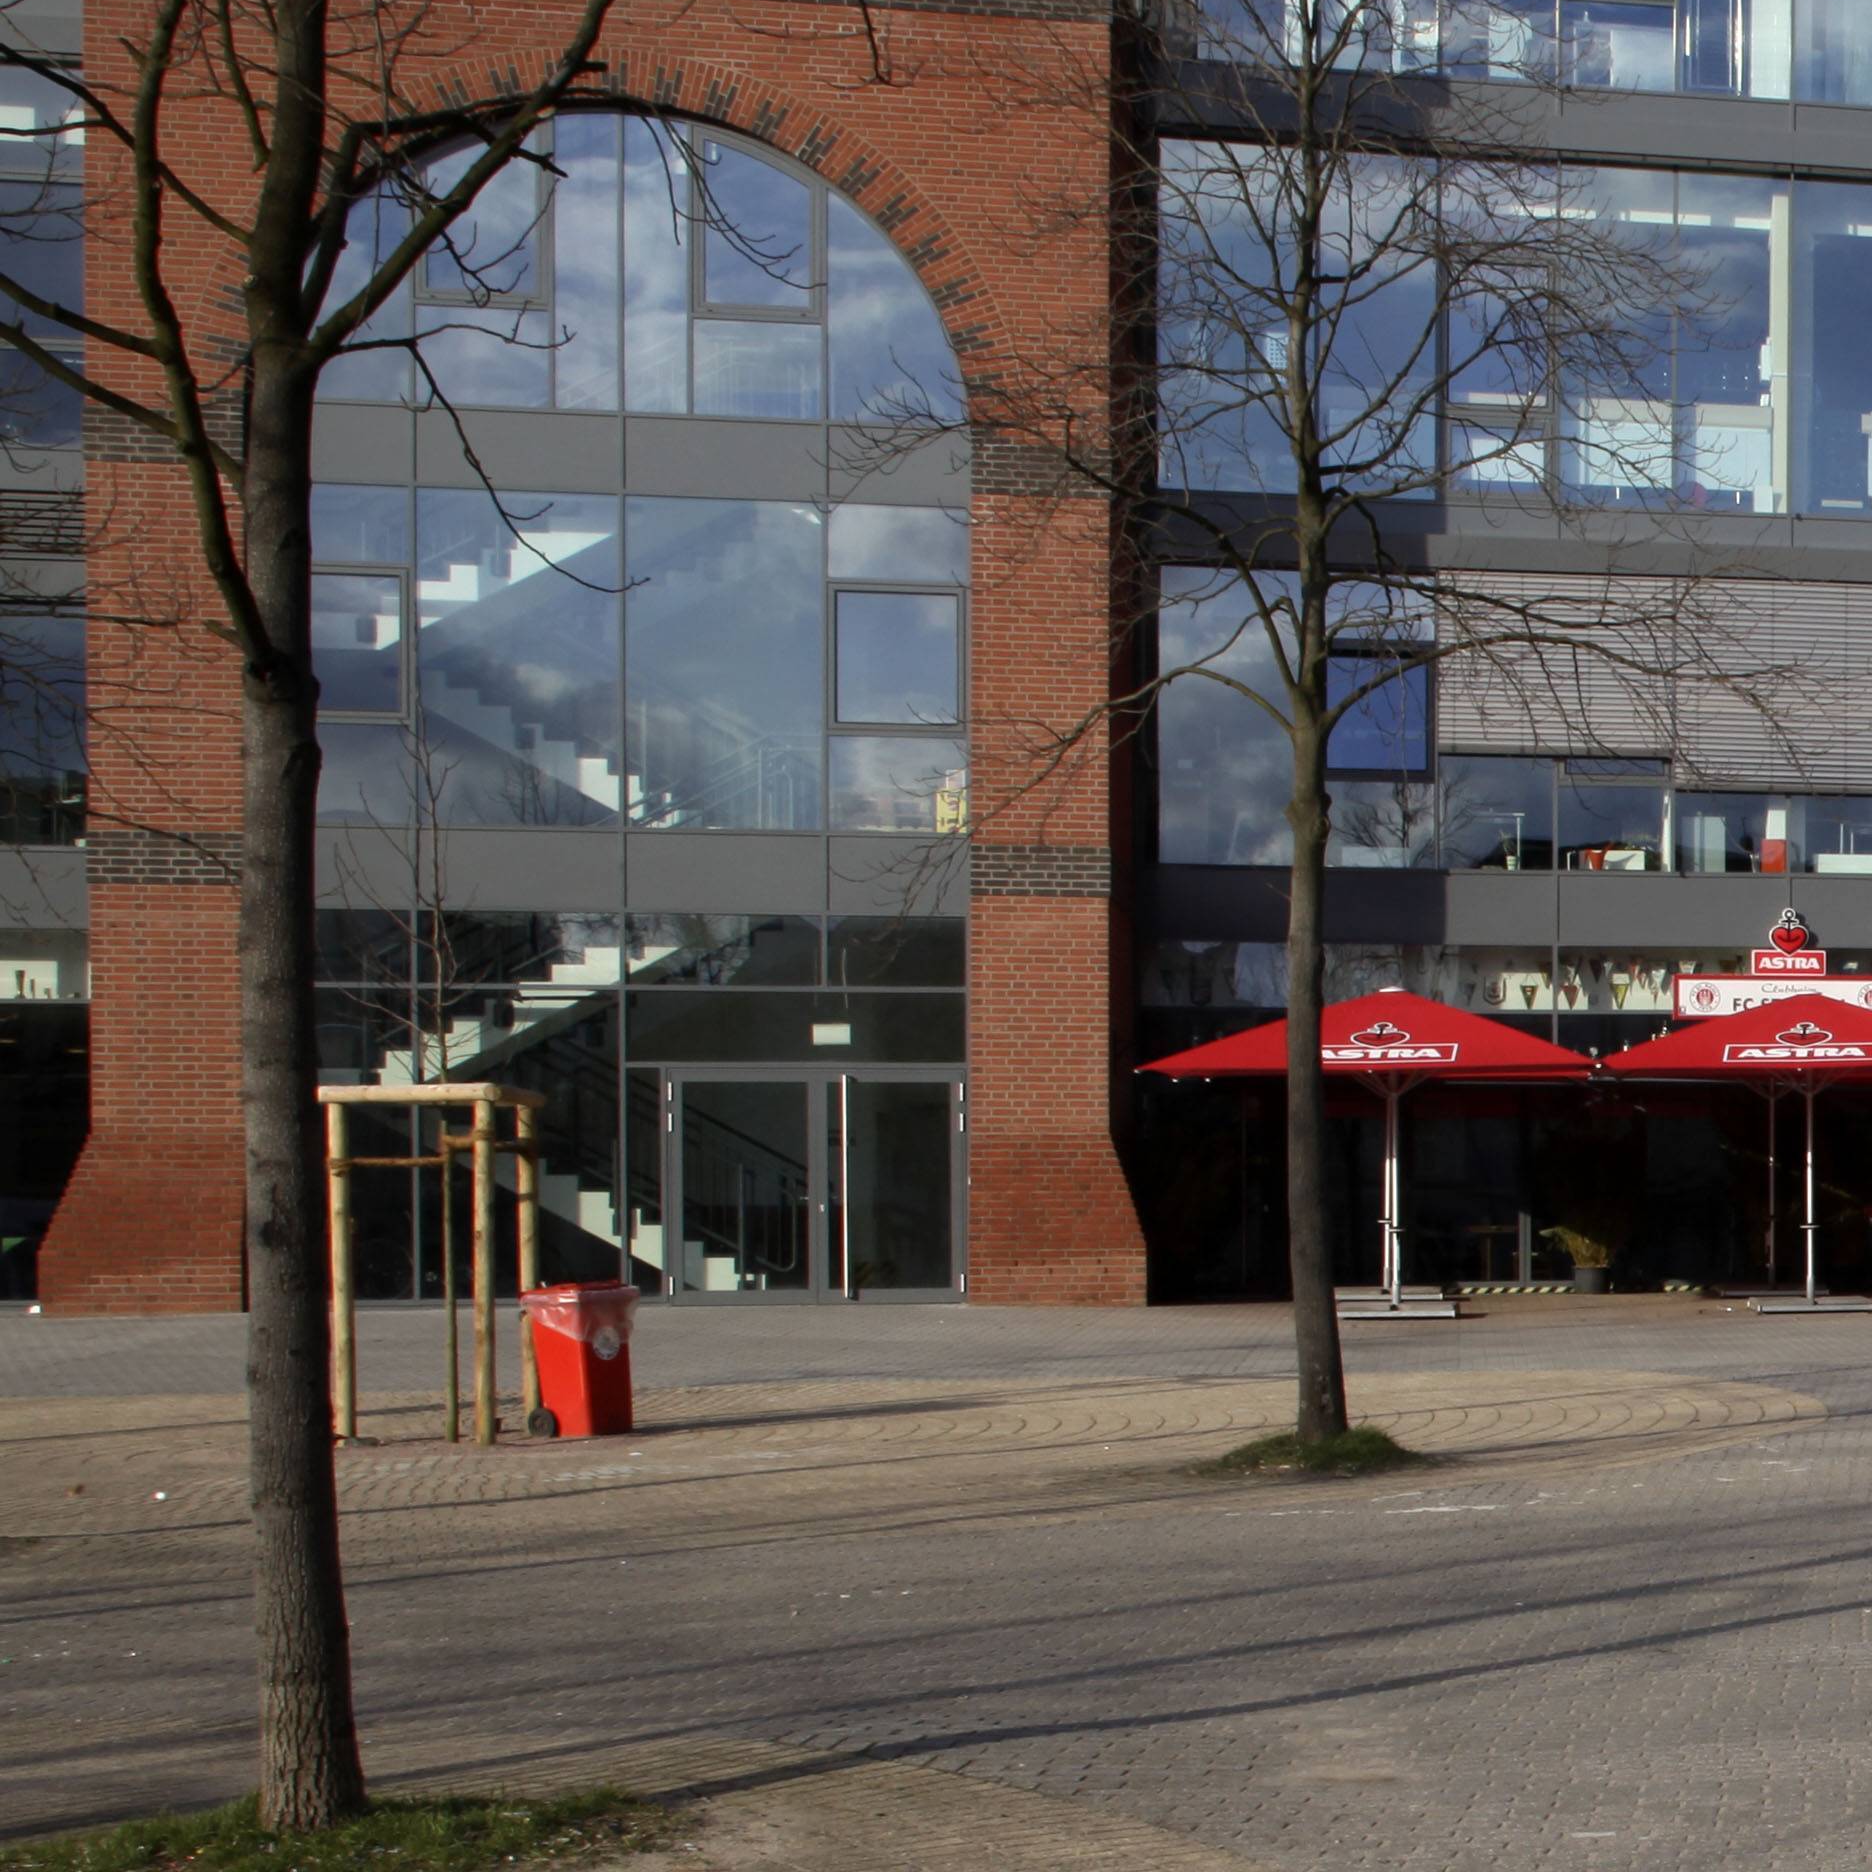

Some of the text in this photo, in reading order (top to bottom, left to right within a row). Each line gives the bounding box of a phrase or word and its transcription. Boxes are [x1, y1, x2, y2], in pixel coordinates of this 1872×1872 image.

[1759, 957, 1820, 970] ASTRA
[1732, 997, 1754, 1012] FC
[1738, 1047, 1865, 1058] ASTRA
